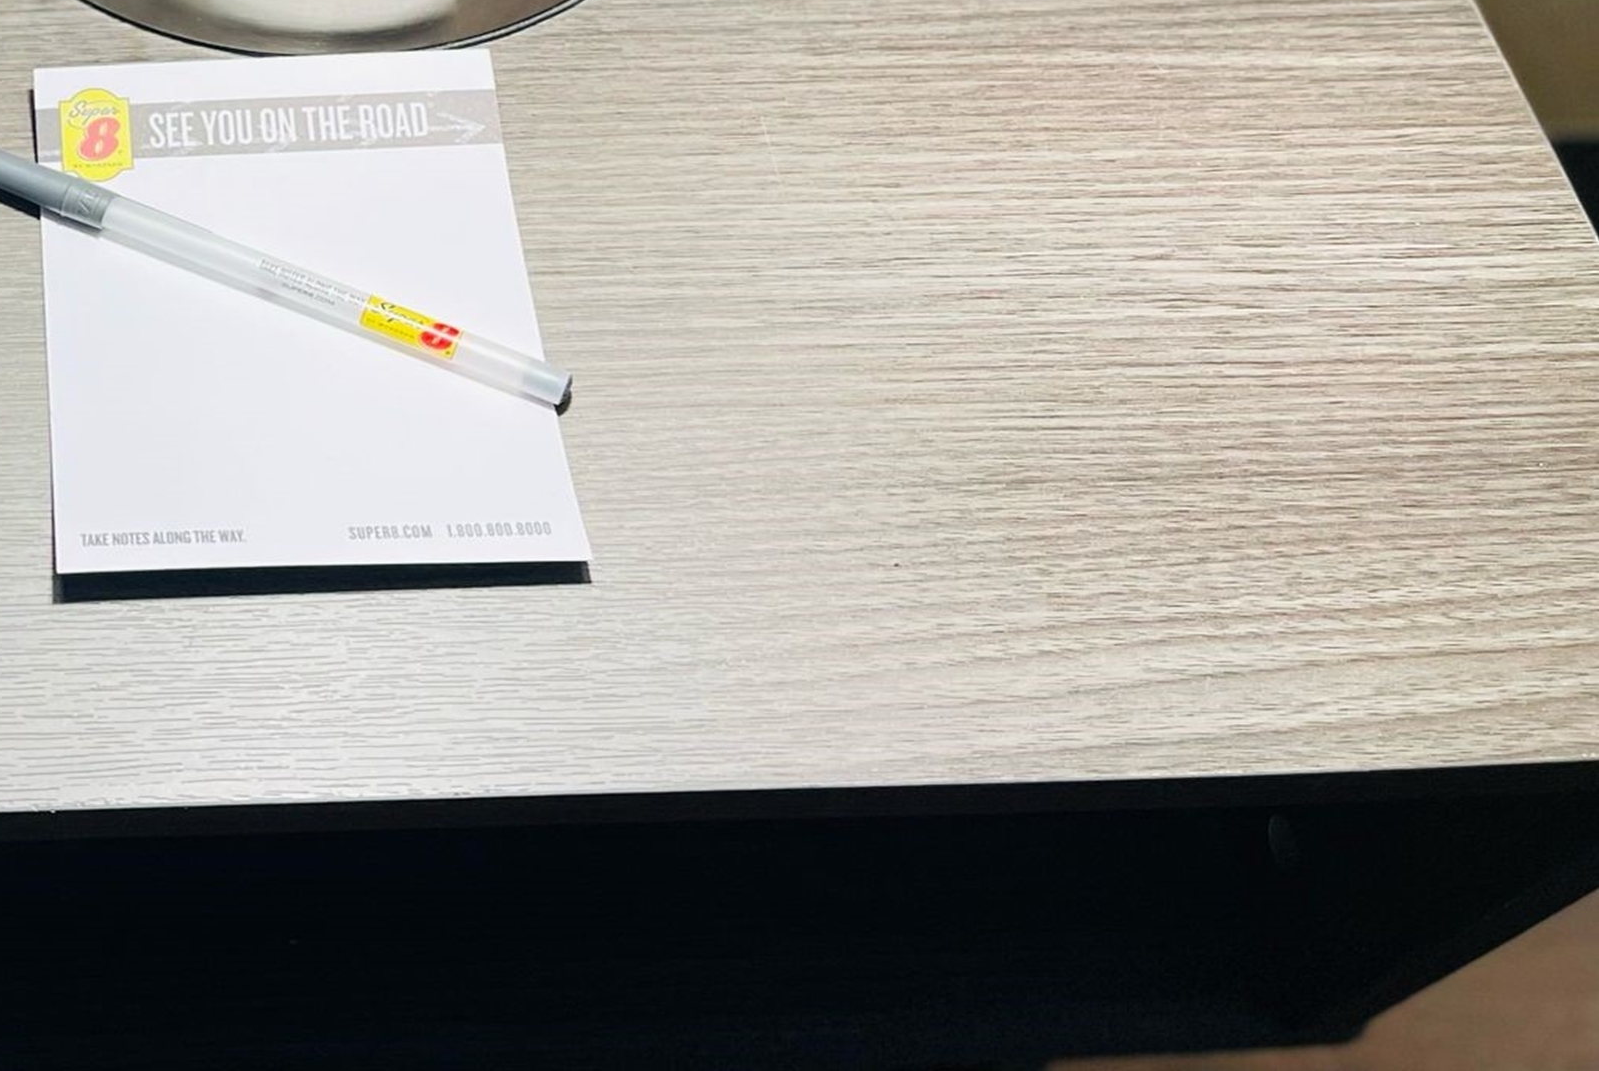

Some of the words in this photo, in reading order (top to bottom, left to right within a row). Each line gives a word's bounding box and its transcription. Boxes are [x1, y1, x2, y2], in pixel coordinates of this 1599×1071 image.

[69, 100, 121, 127] Super
[148, 111, 193, 149] SEE
[201, 106, 252, 146] YOU
[259, 106, 298, 144] ON
[302, 104, 353, 142] THE
[357, 102, 429, 140] ROAD
[77, 116, 122, 161] 8
[418, 322, 460, 350] 8
[80, 532, 110, 547] TAKE
[112, 531, 151, 546] NOTES
[152, 530, 192, 545] ALONG
[193, 529, 217, 544] THE
[217, 528, 248, 543] WAY.
[348, 524, 434, 541] SUPER8.COM
